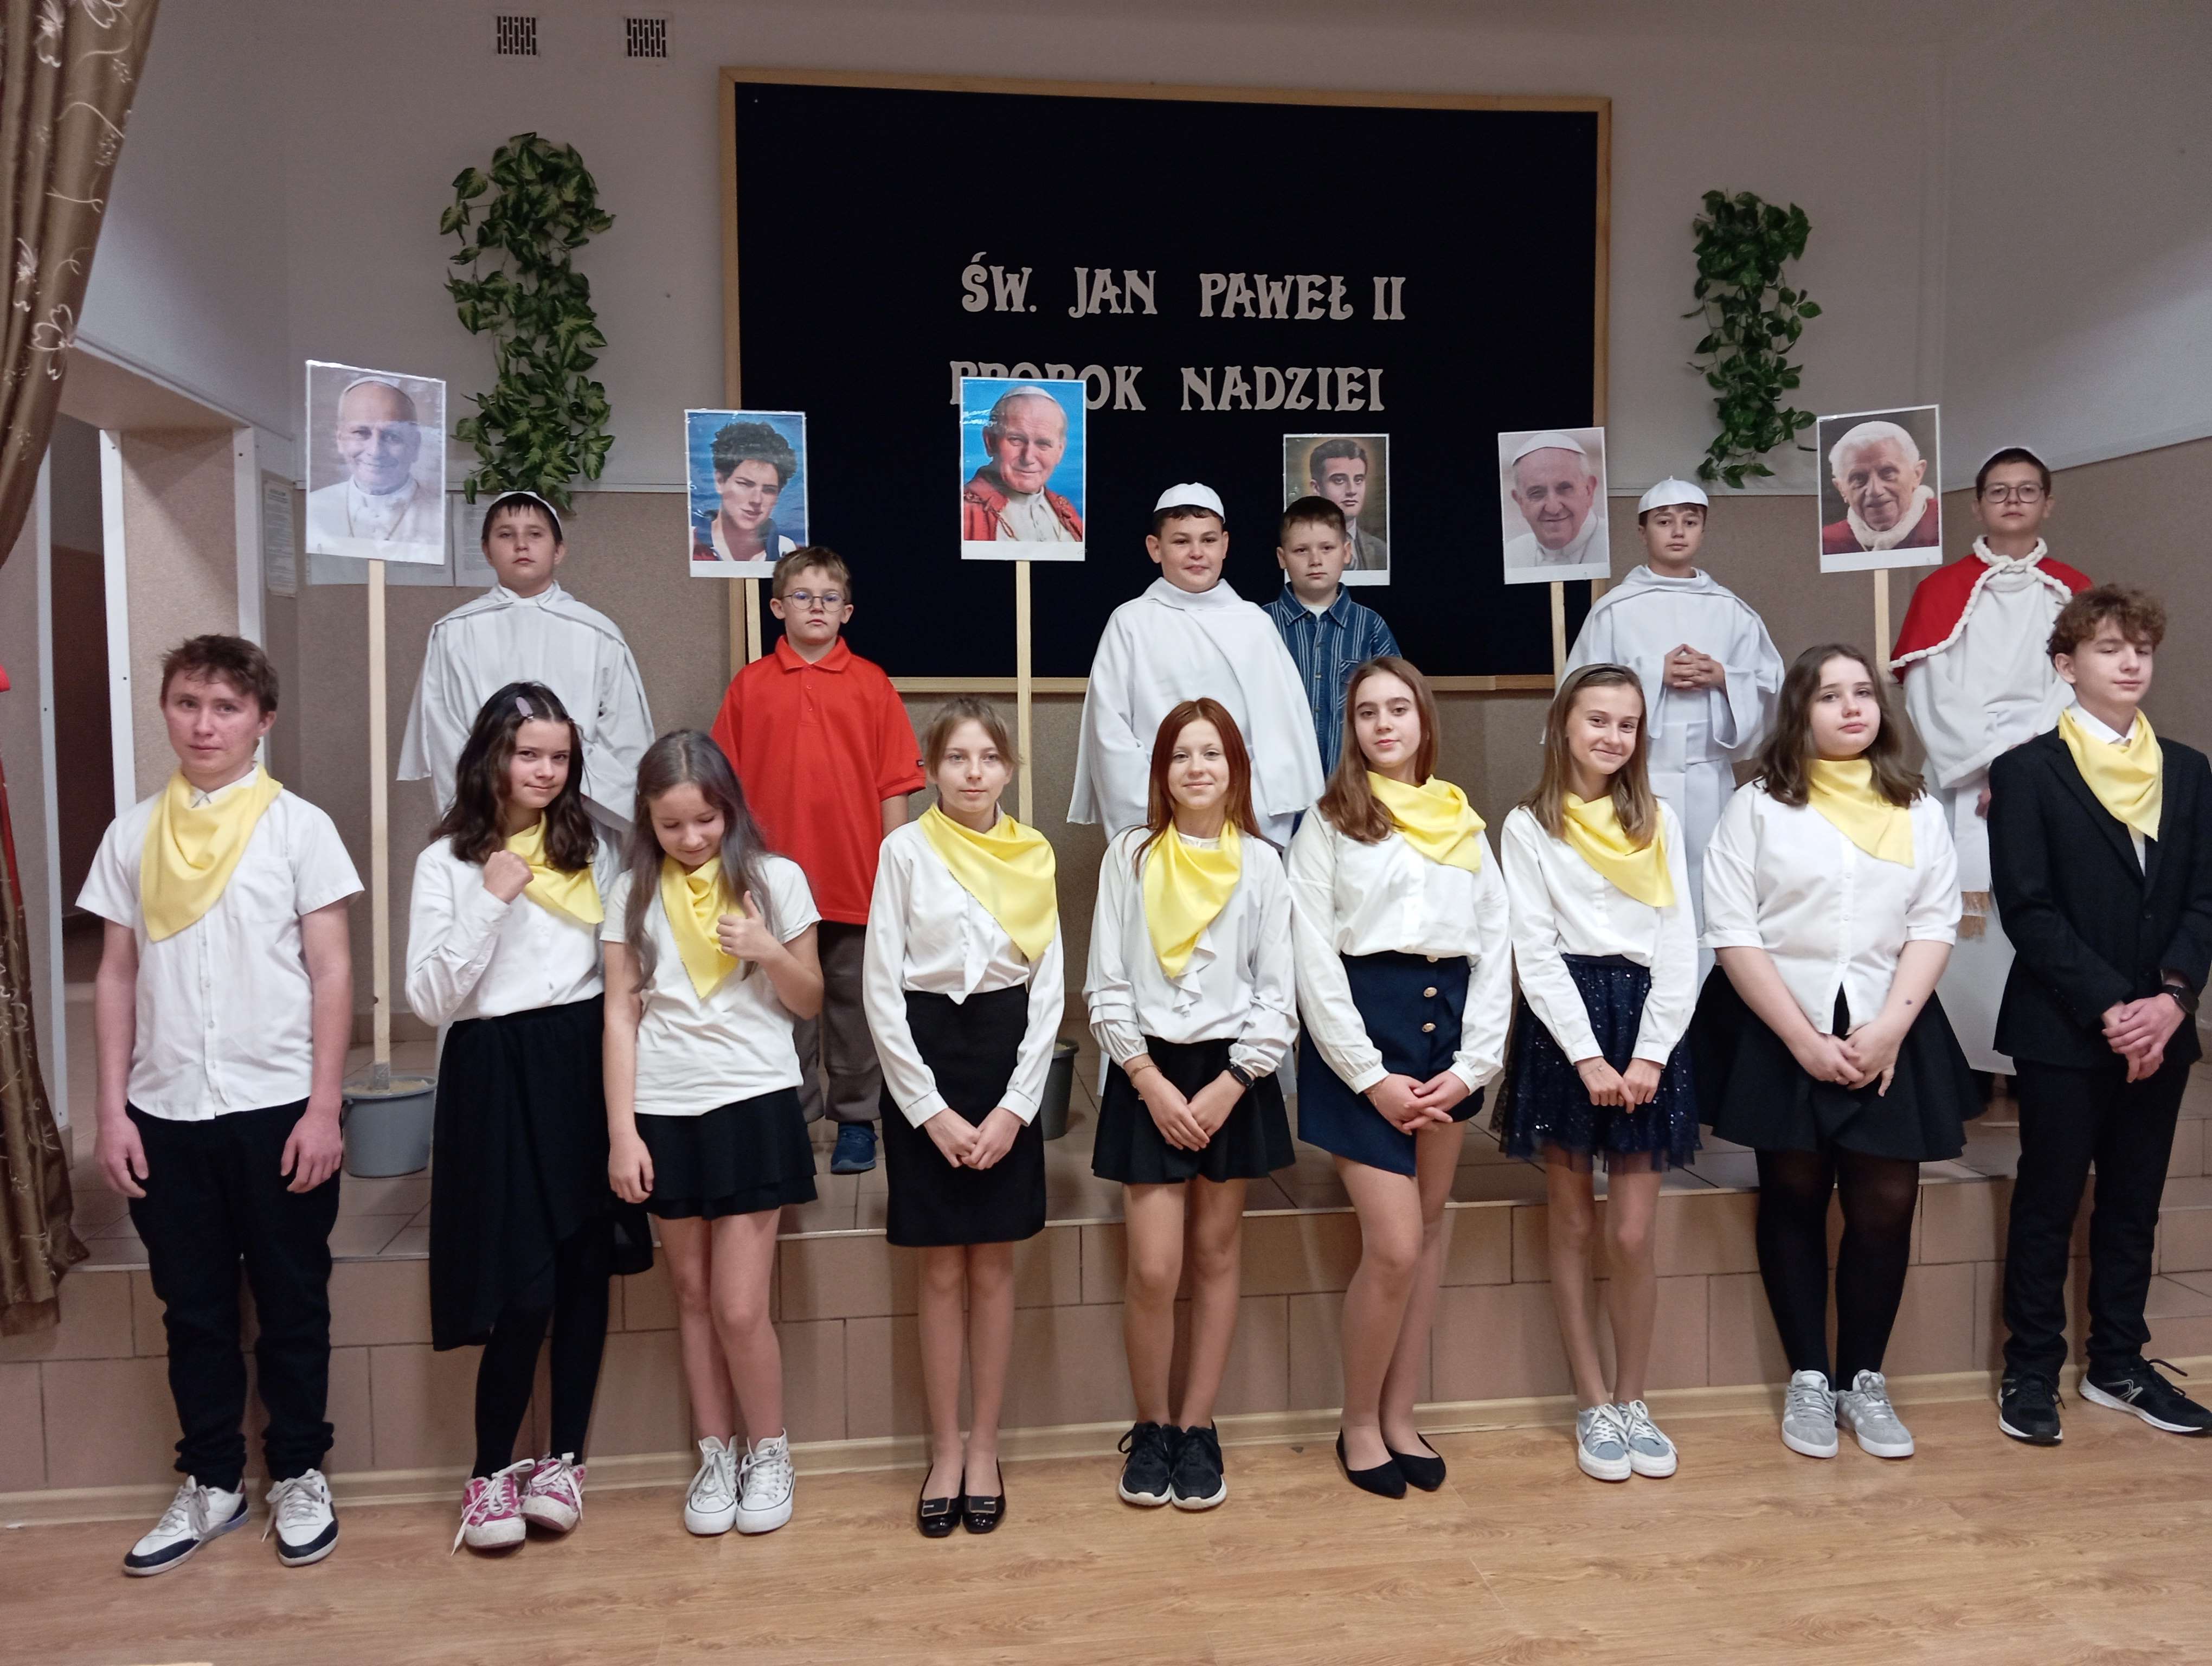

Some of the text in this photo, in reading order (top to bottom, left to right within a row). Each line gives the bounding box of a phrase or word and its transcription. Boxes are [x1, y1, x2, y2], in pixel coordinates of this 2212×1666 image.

[961, 251, 1406, 321] ŚW. JAN PAWEŁ II
[1180, 366, 1385, 412] NADZIEI
